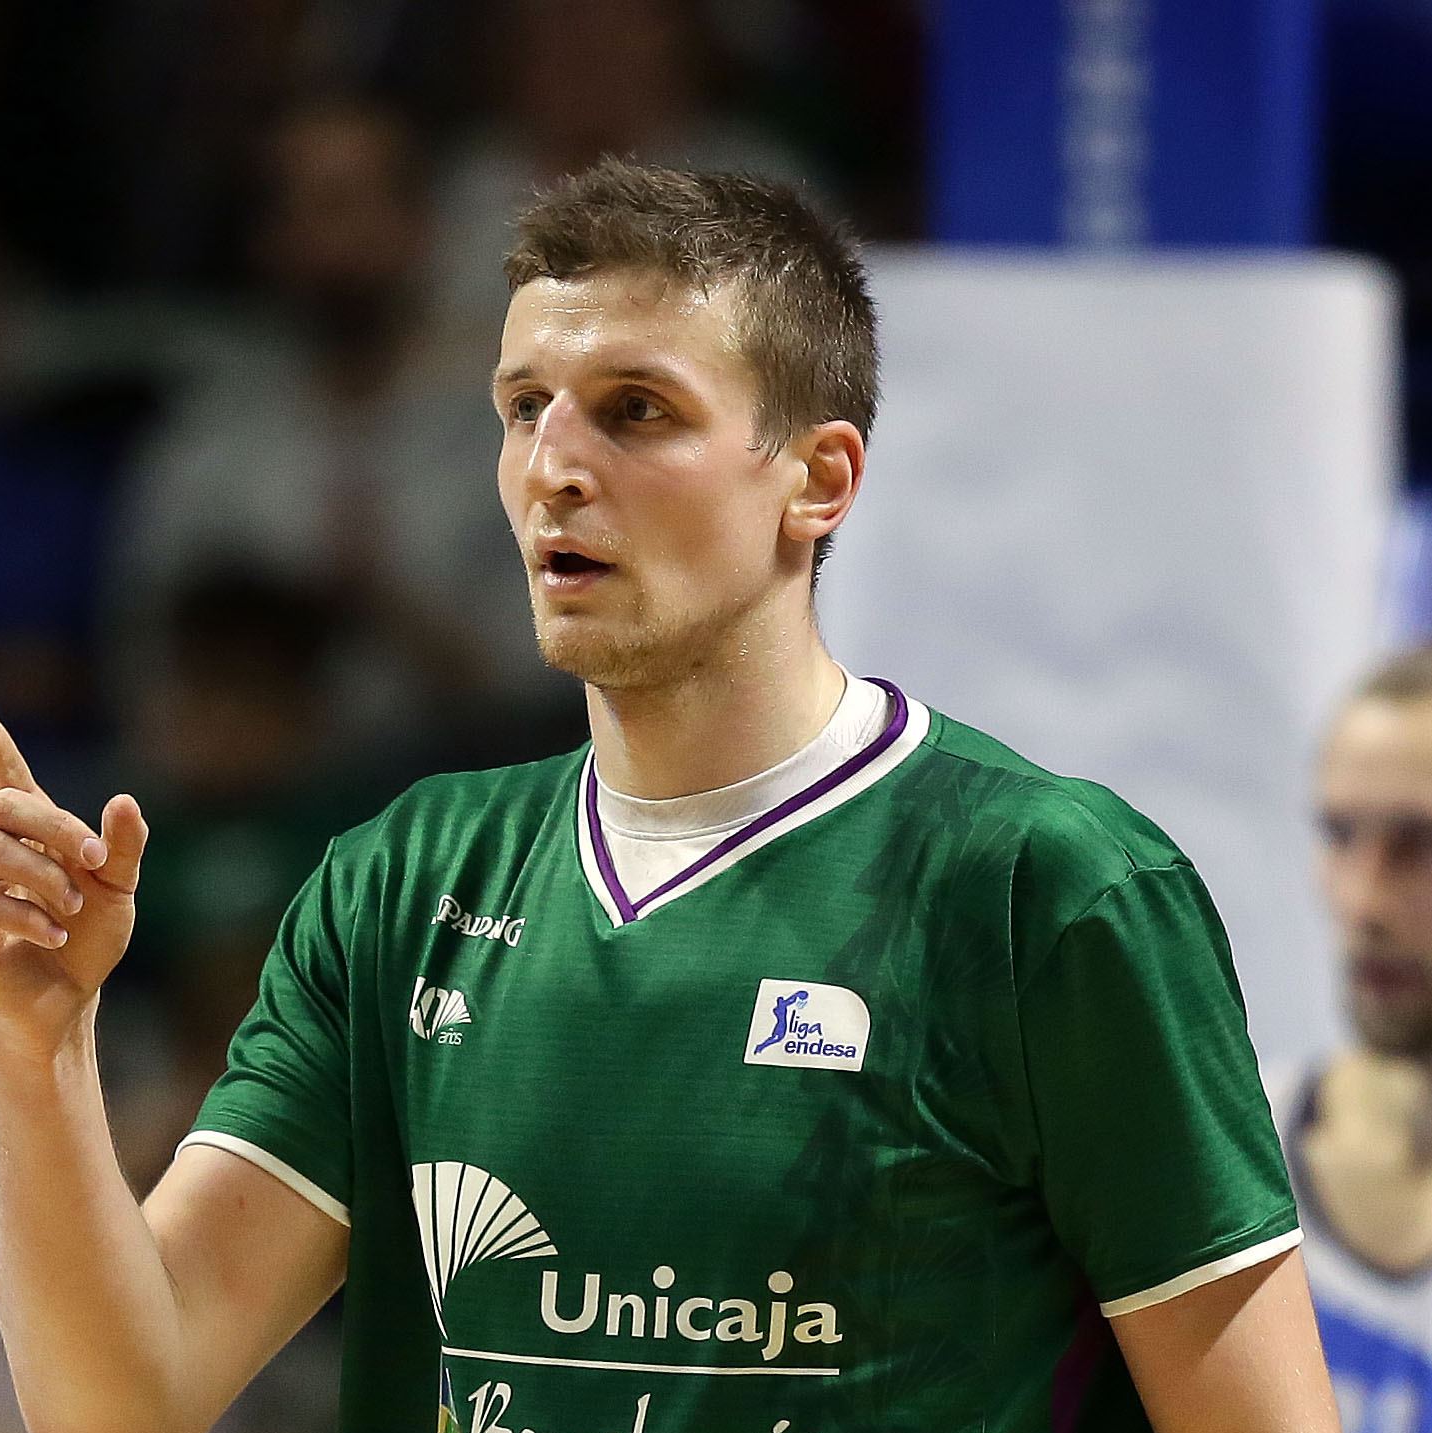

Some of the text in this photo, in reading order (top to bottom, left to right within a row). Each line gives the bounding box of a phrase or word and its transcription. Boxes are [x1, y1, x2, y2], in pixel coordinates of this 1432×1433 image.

[788, 1009, 823, 1040] liga
[784, 1038, 857, 1059] endesa
[540, 1265, 843, 1361] Unicaja
